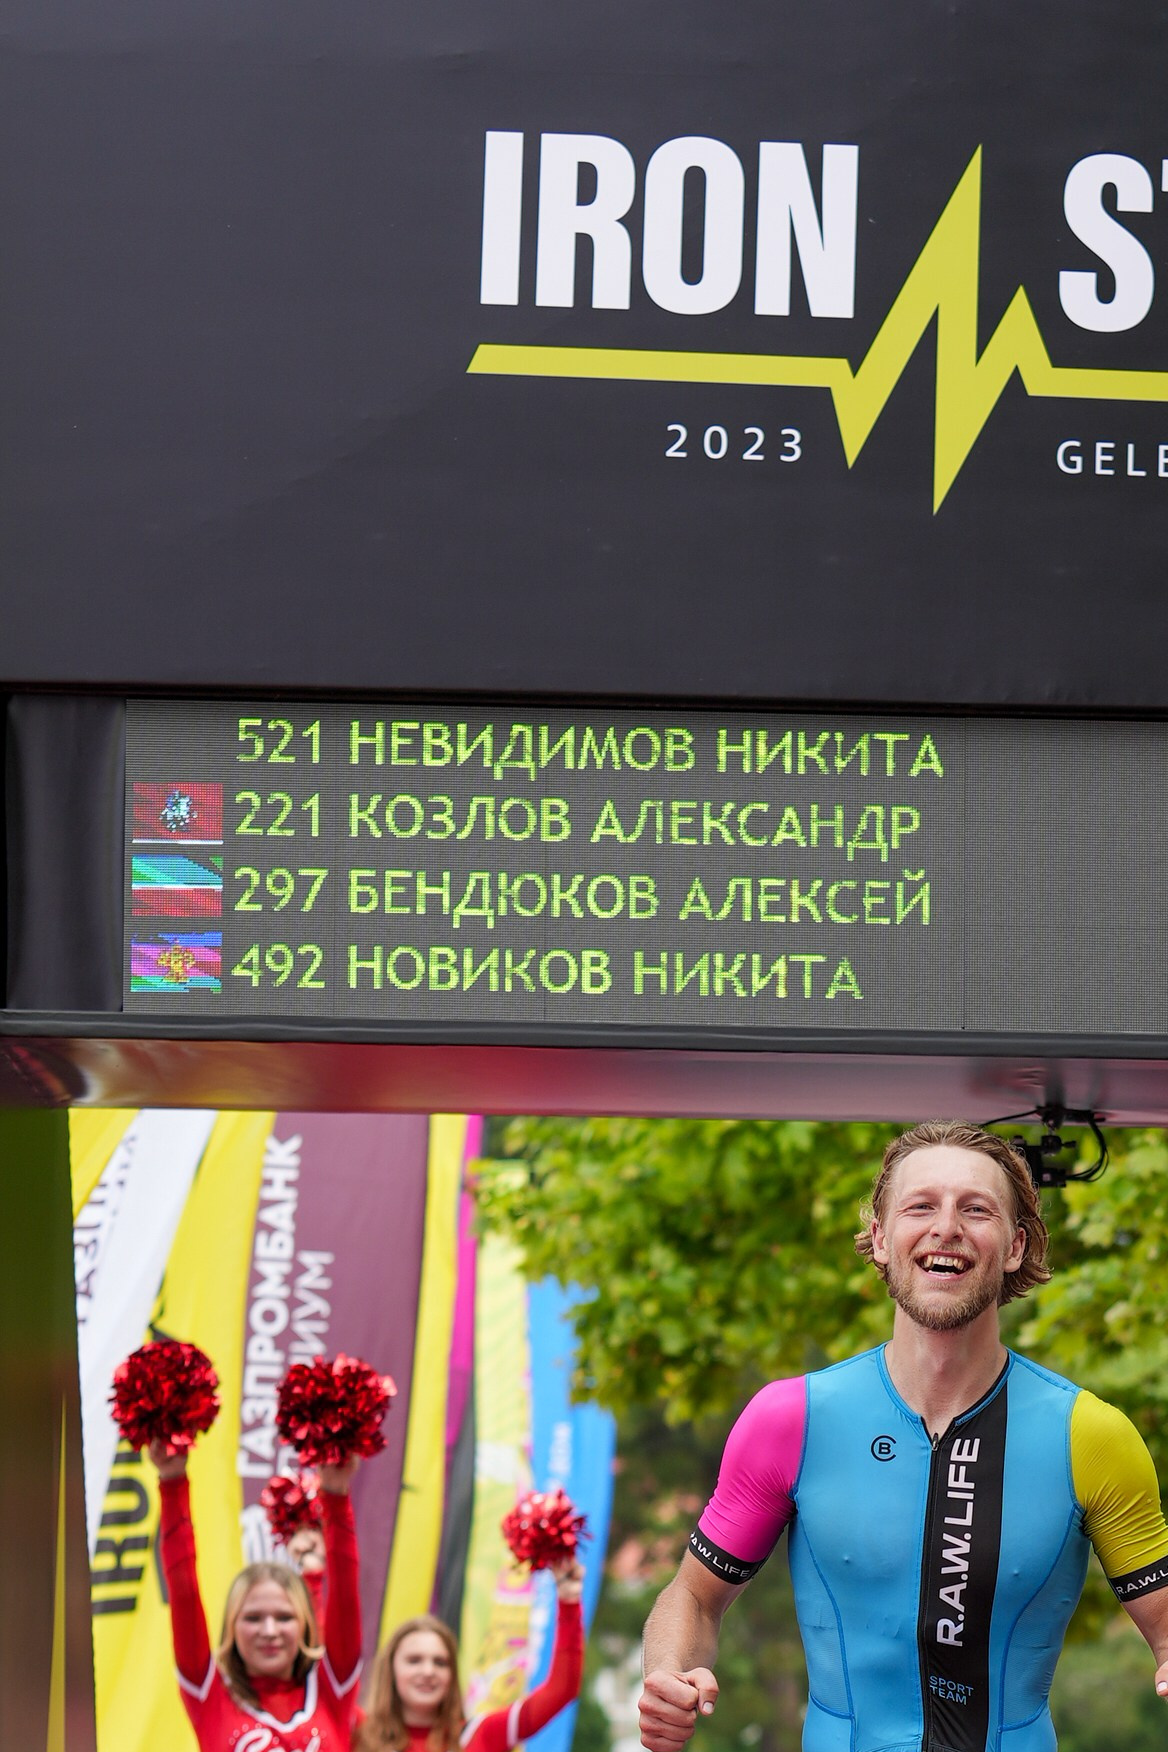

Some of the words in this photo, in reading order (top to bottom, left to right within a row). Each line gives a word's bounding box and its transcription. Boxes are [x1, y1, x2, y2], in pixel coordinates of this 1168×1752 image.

[481, 130, 860, 320] IRON
[664, 423, 804, 463] 2023
[236, 718, 324, 764] 521
[349, 721, 696, 782] НЕВИДИМОВ
[716, 730, 944, 778] НИКИТА
[233, 793, 324, 838] 221
[349, 794, 571, 843] КОЗЛОВ
[589, 798, 922, 862] АЛЕКСАНДР
[233, 868, 330, 913] 297
[349, 868, 660, 929] БЕНДЮКОВ
[678, 869, 932, 926] АЛЕКСЕЙ
[232, 944, 327, 990] 492
[348, 944, 612, 995] НОВИКОВ
[633, 951, 865, 1000] НИКИТА
[237, 1133, 303, 1479] ГАЗПРОМБАНК
[91, 1437, 152, 1616] IRO
[936, 1437, 981, 1648] R.A.W.LIFE
[929, 1675, 975, 1697] SPORT
[930, 1686, 967, 1706] TEAM
